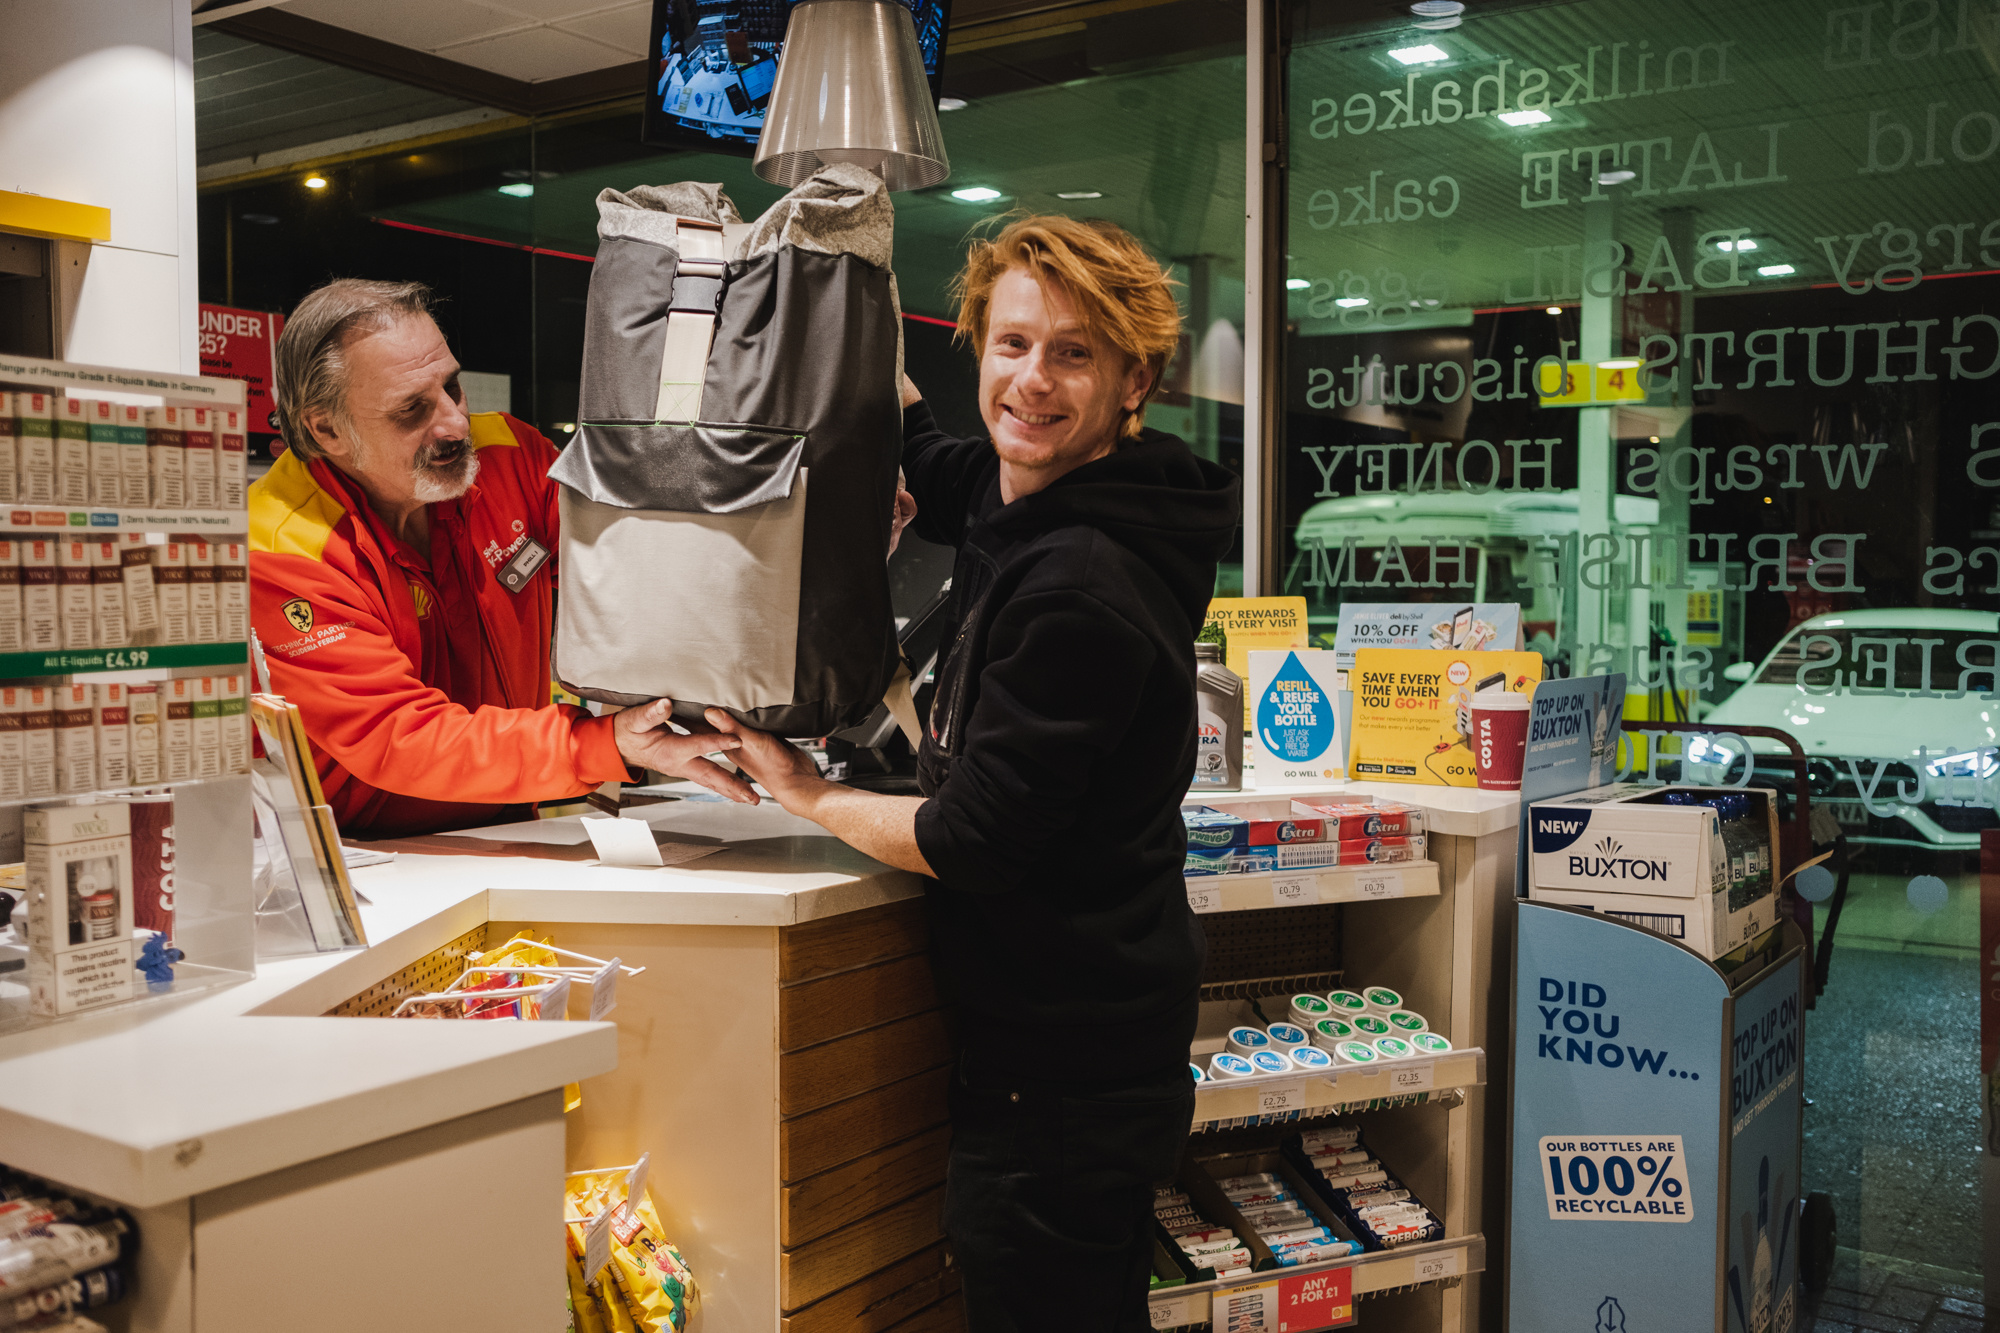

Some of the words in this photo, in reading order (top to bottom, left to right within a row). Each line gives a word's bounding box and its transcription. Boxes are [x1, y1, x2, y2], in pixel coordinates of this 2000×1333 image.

[222, 359, 232, 369] be
[40, 366, 75, 379] Pharma
[78, 371, 104, 382] Grade
[146, 378, 168, 389] Made
[180, 382, 216, 396] Germany
[241, 375, 263, 385] show
[1607, 369, 1626, 393] 4
[1238, 608, 1296, 619] REWARDS
[1402, 613, 1410, 622] by
[1410, 612, 1424, 621] Shell
[1229, 619, 1265, 629] EVERY
[1269, 618, 1299, 628] VISIT
[1354, 624, 1384, 637] 10%
[1388, 624, 1419, 637] OFF
[271, 633, 317, 654] TECHNICAL
[288, 643, 319, 658] SCUDERIA
[317, 632, 347, 648] FERRARI
[44, 656, 59, 667] All
[60, 654, 103, 668] E-liquids
[105, 650, 150, 669] £4.99
[1363, 672, 1396, 684] SAVE
[1400, 673, 1442, 685] EVERY
[1276, 680, 1312, 692] REFILL
[1362, 684, 1392, 696] TIME
[1397, 685, 1440, 698] WHEN
[1269, 692, 1280, 703] &
[1283, 692, 1320, 703] REUSE
[1361, 696, 1390, 708] YOU
[1395, 697, 1425, 710] GO+
[1429, 698, 1441, 710] IT
[1277, 703, 1313, 715] YOUR
[1536, 697, 1555, 717] TOP
[1556, 695, 1570, 714] UP
[1570, 693, 1585, 712] ON
[1275, 714, 1317, 726] BOTTLE
[1409, 717, 1440, 725] programme
[1283, 729, 1296, 737] JUST
[1297, 729, 1310, 737] ASK
[1531, 713, 1582, 742] BUXTON
[1285, 742, 1298, 751] FREE
[1298, 742, 1310, 751] TAP
[1286, 736, 1295, 744] US
[1295, 736, 1309, 744] FOR
[1480, 718, 1493, 769] COSTA
[1287, 749, 1309, 758] WATER
[1284, 770, 1297, 778] GO
[1299, 770, 1318, 778] WELL
[1446, 765, 1464, 776] GO
[1281, 825, 1315, 839] Extra
[1367, 819, 1400, 834] Extra
[56, 841, 126, 857] VAPORISER
[159, 824, 175, 911] COSTA
[1568, 856, 1668, 881] BUXTON
[1279, 884, 1301, 895] £0.79
[1364, 882, 1385, 892] £0.79
[1743, 920, 1761, 941] BUXTON
[71, 954, 87, 963] This
[89, 947, 119, 962] product
[63, 963, 95, 976] contains
[97, 957, 127, 970] nicotine
[77, 973, 100, 984] which
[101, 971, 108, 979] is
[66, 987, 90, 999] highly
[92, 979, 125, 993] addictive
[1539, 977, 1607, 1009] DID
[1537, 1005, 1620, 1039] YOU
[1733, 1022, 1758, 1069] TOP
[1761, 1007, 1778, 1045] UP
[1780, 991, 1797, 1030] ON
[1538, 1033, 1700, 1081] KNOW...
[1397, 1072, 1419, 1083] £2.35
[1732, 1027, 1797, 1118] BUXTON
[1263, 1095, 1287, 1107] £2.79
[1732, 1118, 1744, 1139] AND
[1744, 1108, 1754, 1127] GET
[1754, 1087, 1778, 1118] THROUGH
[1777, 1079, 1788, 1096] THE
[1787, 1070, 1797, 1090] DAY
[1546, 1141, 1577, 1153] OUR
[1580, 1141, 1643, 1152] BOTTLES
[1646, 1142, 1676, 1152] ARE
[1548, 1155, 1683, 1199] 100%
[1555, 1199, 1686, 1216] RECYCLABLE
[1381, 1228, 1428, 1244] TREBOR
[1422, 1263, 1444, 1274] £0.79
[1303, 1277, 1329, 1292] ANY
[1290, 1294, 1299, 1306] 2
[1301, 1289, 1324, 1304] FOR
[1325, 1286, 1338, 1299] £1
